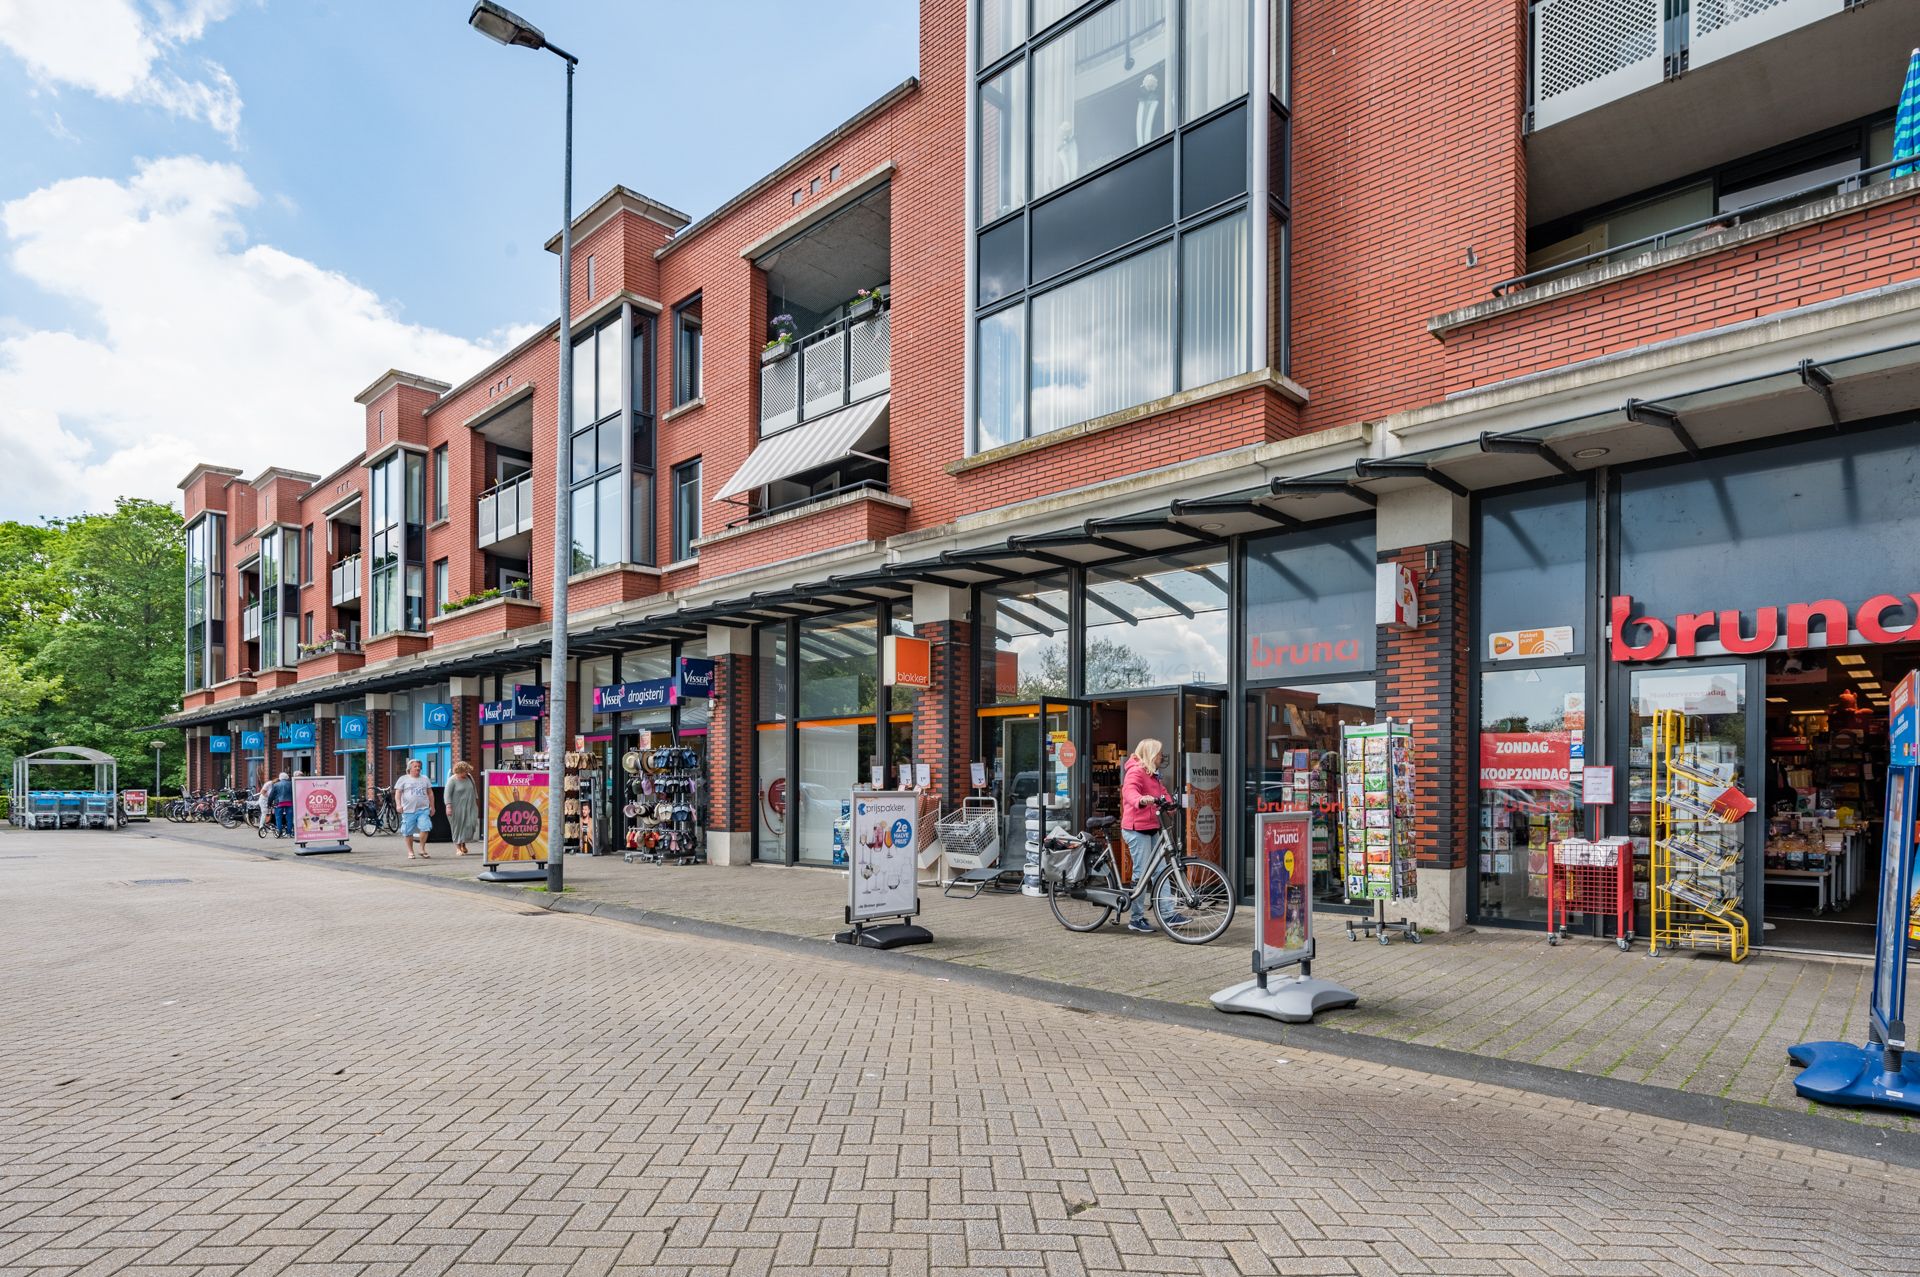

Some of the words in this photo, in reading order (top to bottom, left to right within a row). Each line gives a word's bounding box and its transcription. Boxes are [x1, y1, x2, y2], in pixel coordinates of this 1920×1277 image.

[1251, 637, 1359, 668] bruna
[628, 686, 664, 705] drogisterij
[1191, 766, 1219, 777] welkom
[1480, 768, 1569, 781] KOOPZONDAG
[309, 794, 334, 804] 20%
[500, 810, 539, 825] 40%
[501, 824, 539, 833] KORTING
[895, 821, 908, 832] 2e
[1273, 829, 1299, 844] bruna
